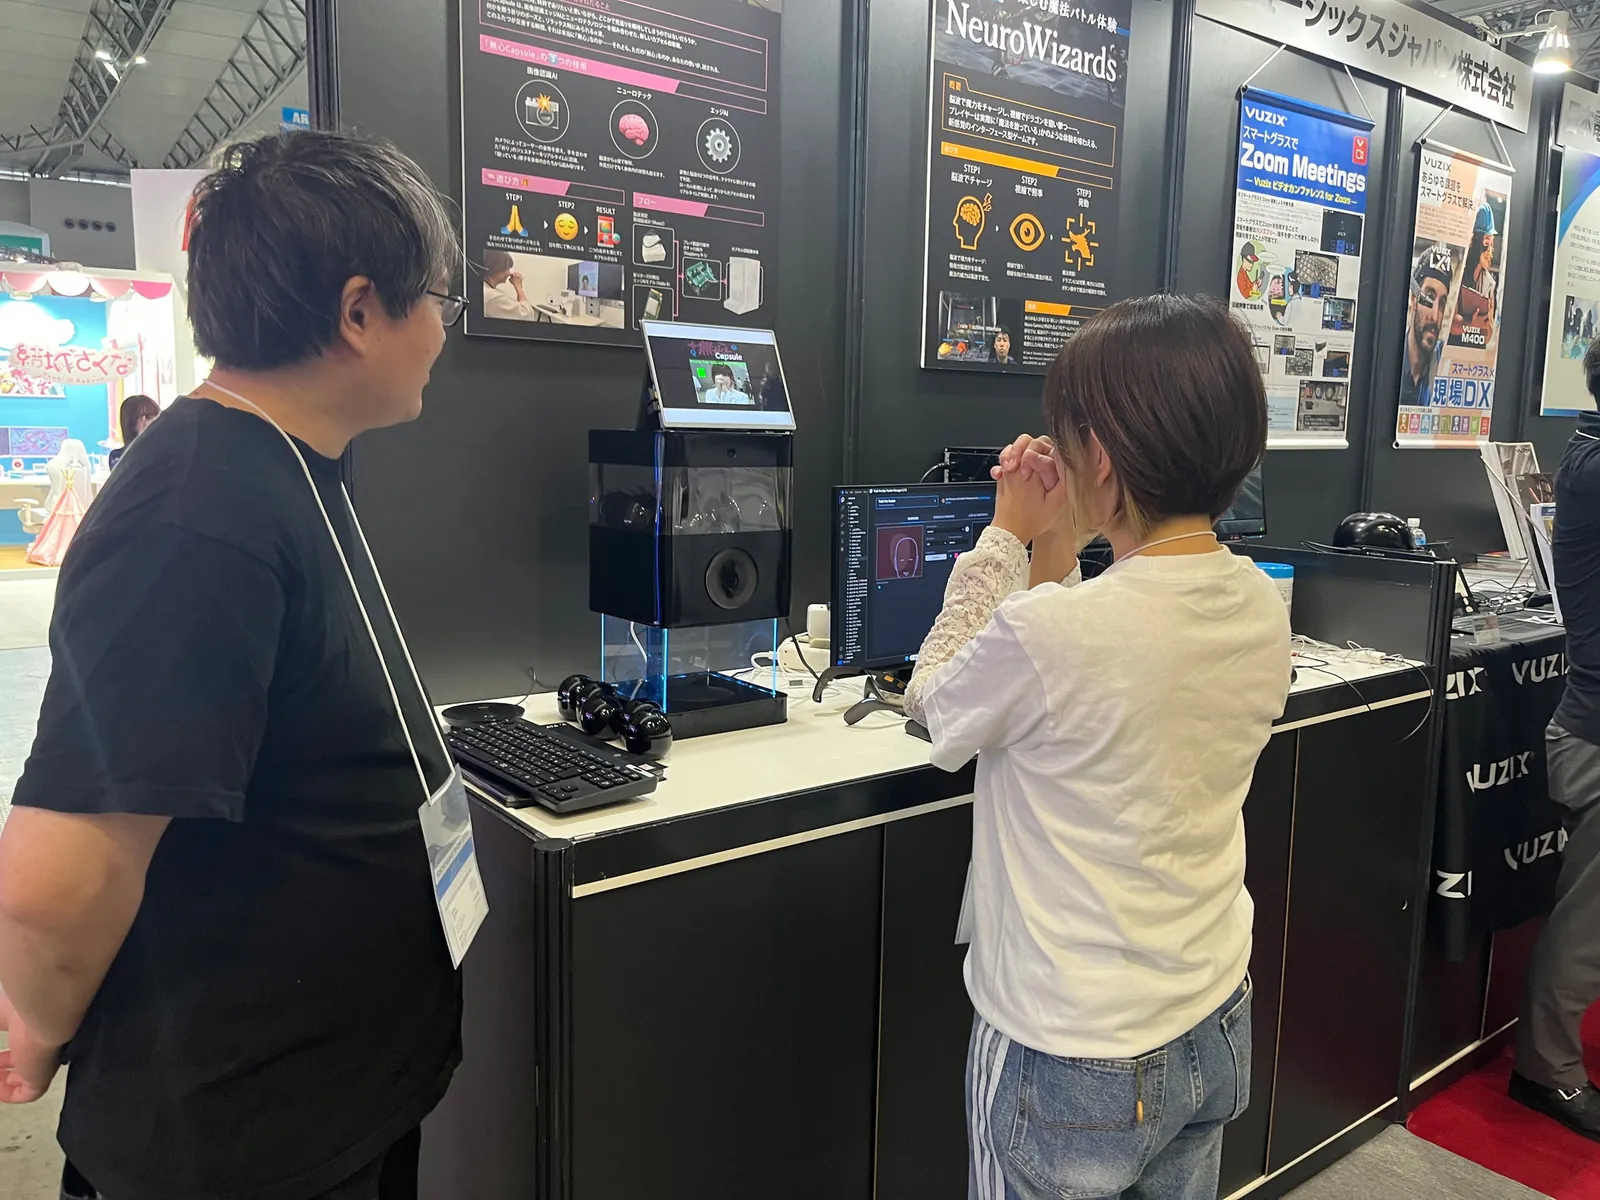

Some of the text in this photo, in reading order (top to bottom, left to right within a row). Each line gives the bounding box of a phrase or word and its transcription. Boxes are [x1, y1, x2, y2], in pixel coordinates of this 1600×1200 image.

[1018, 0, 1118, 35] む魔法バトル体験
[945, 0, 1118, 83] NeuroWizards
[616, 86, 652, 100] ニューロテック
[709, 106, 729, 117] エッジAI
[1244, 105, 1286, 127] VUZIX
[1243, 126, 1298, 150] スマートグラスで
[963, 163, 981, 175] STEP1
[1240, 142, 1365, 193] Zoom Meetings
[1423, 156, 1451, 173] VUZIX
[950, 171, 993, 188] 脳波でチャージ
[1021, 175, 1038, 187] STEP2
[1421, 171, 1461, 193] あらゆる課題を
[505, 192, 523, 202] STEP1
[1076, 187, 1092, 198] STEP3
[1254, 176, 1351, 205] Vuzix ビデオカンファレンス for Zoom
[557, 200, 575, 210] STEP2
[638, 196, 656, 205] フロー
[1078, 199, 1090, 208] 発動
[1420, 185, 1477, 212] スマートグラスで解決。
[596, 206, 616, 215] RESULT
[1462, 325, 1480, 334] VUZIX
[1461, 333, 1485, 345] M400
[714, 351, 743, 361] Capsule
[1434, 379, 1492, 408] 現場DX
[1511, 652, 1571, 686] VUZI
